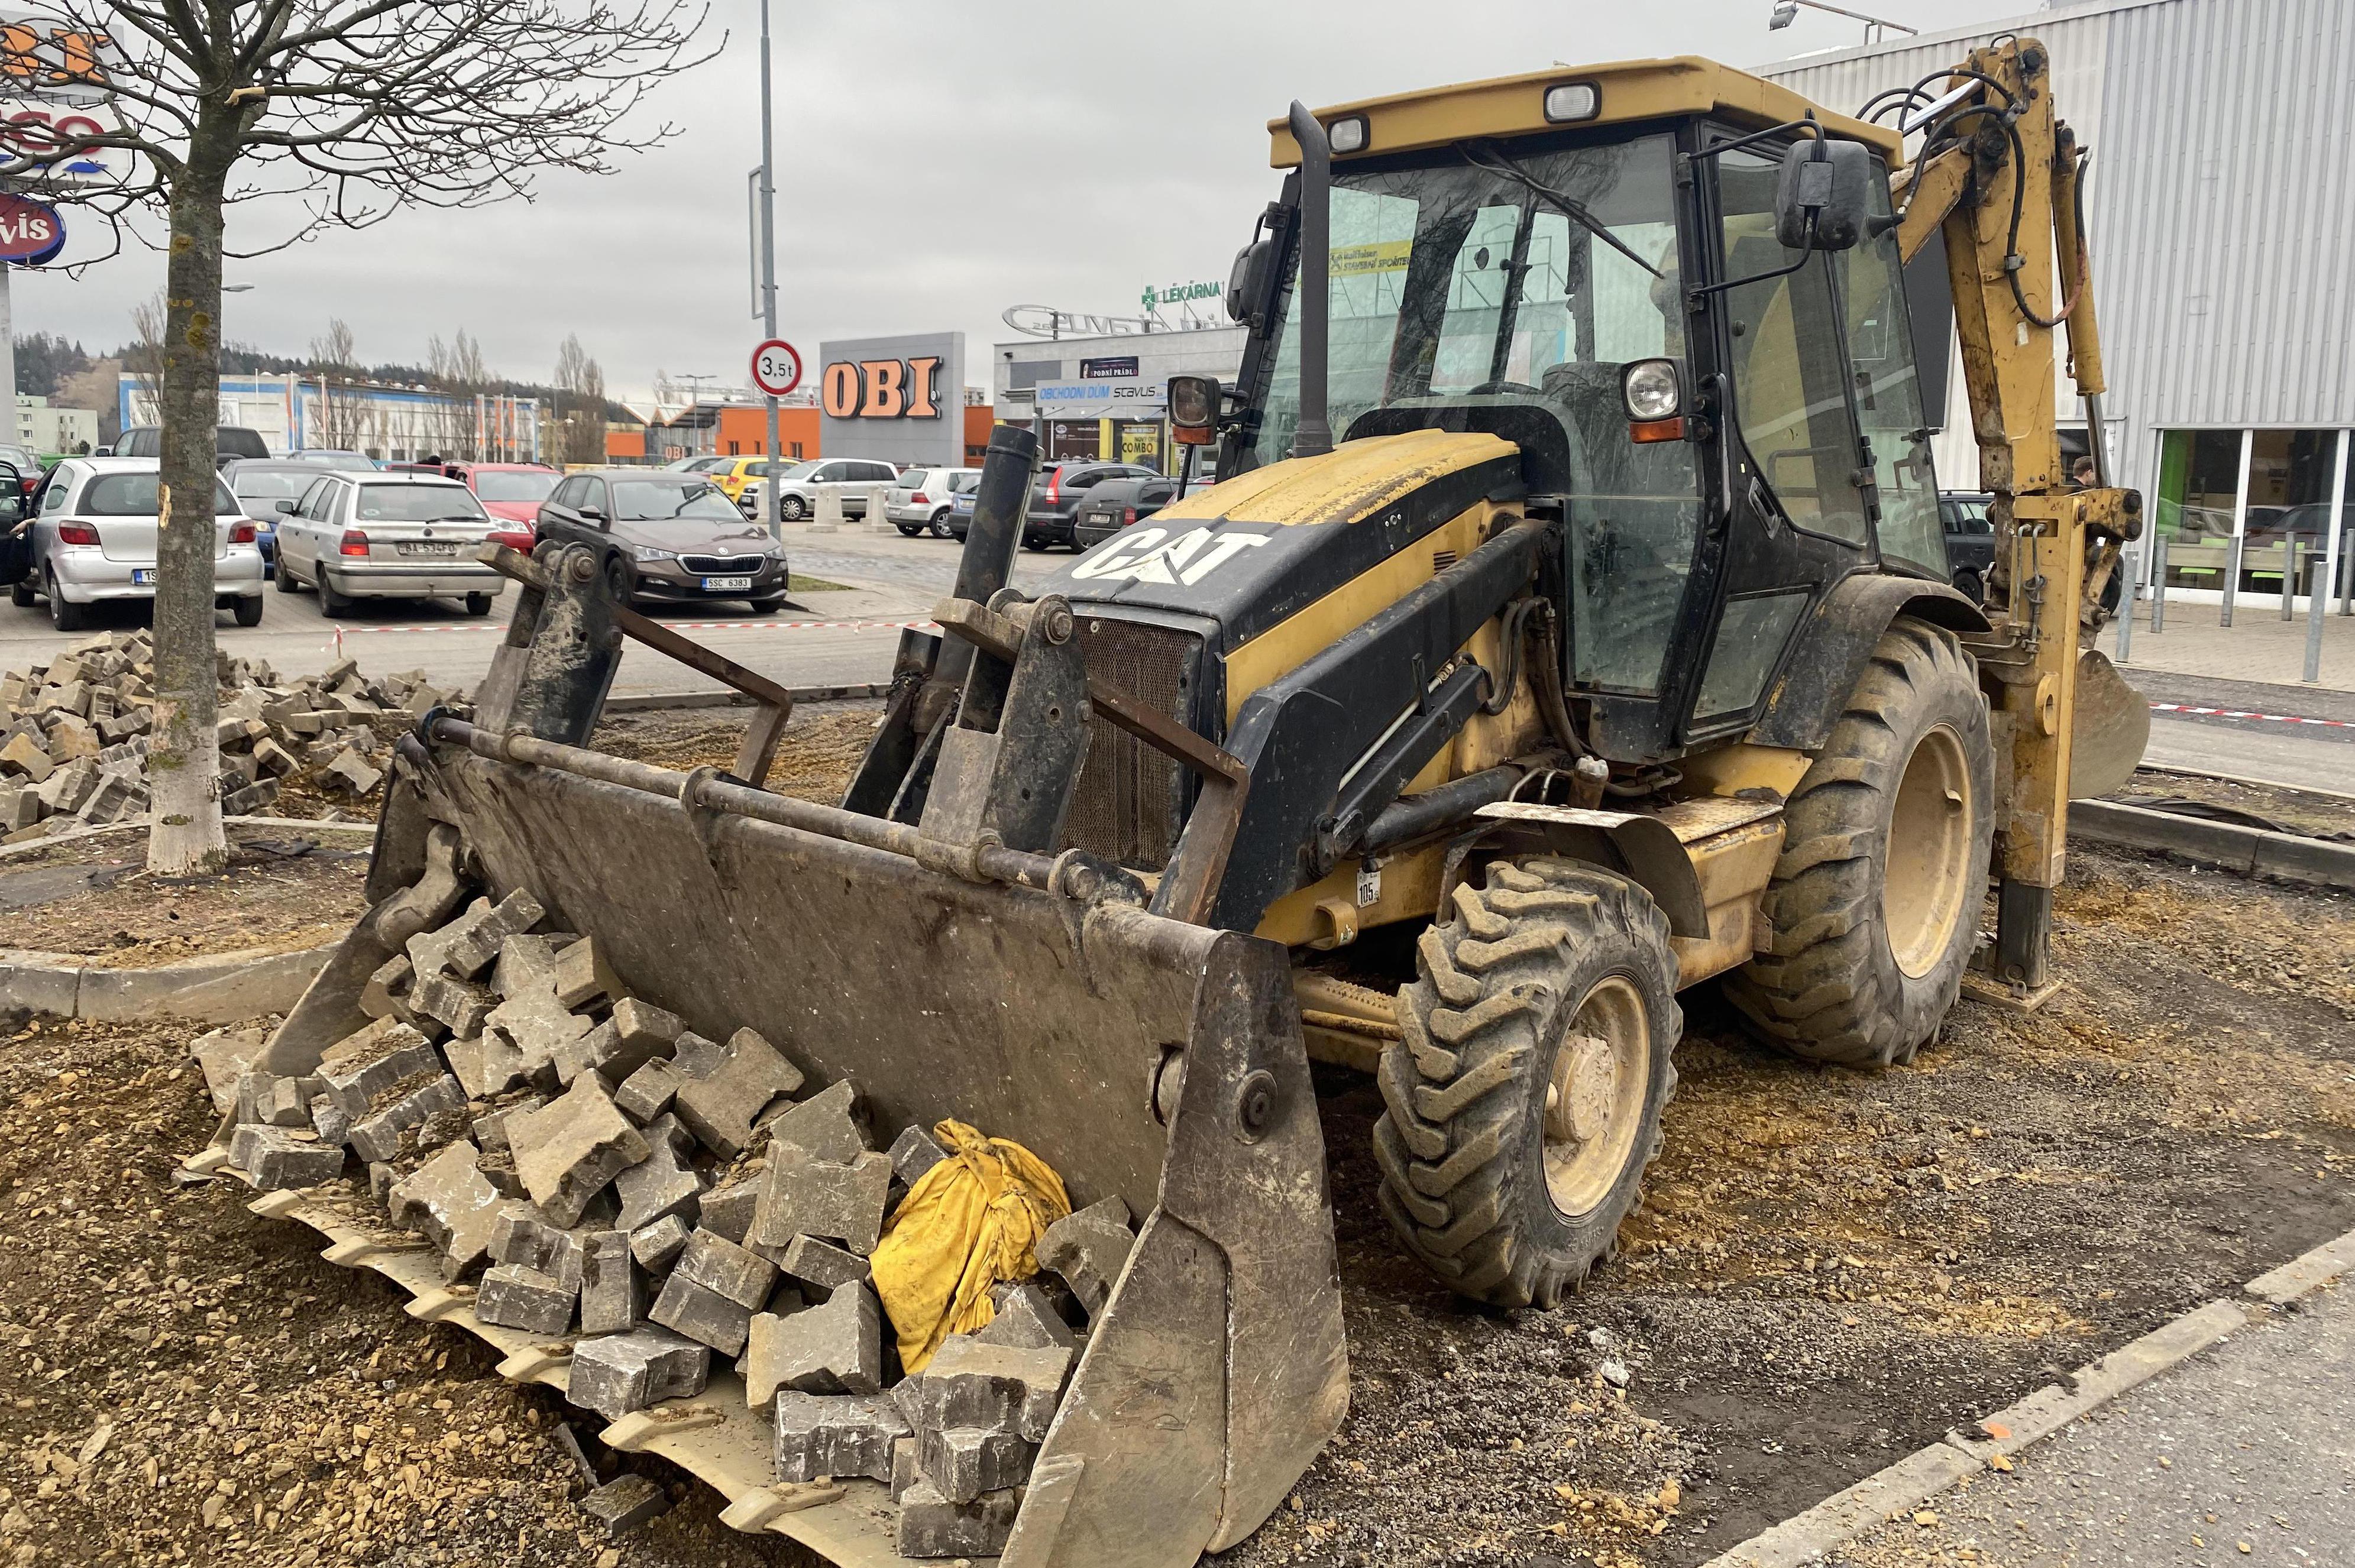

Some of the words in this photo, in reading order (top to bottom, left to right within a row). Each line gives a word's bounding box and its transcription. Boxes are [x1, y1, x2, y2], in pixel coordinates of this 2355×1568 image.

[0, 109, 106, 155] CO
[0, 212, 50, 244] vis
[1114, 367, 1138, 376] PRÁDLO
[823, 356, 940, 419] OBI
[1122, 442, 1153, 453] COMBO
[1071, 526, 1273, 586] CAT
[709, 579, 723, 587] 5SC
[1360, 882, 1373, 905] 105
